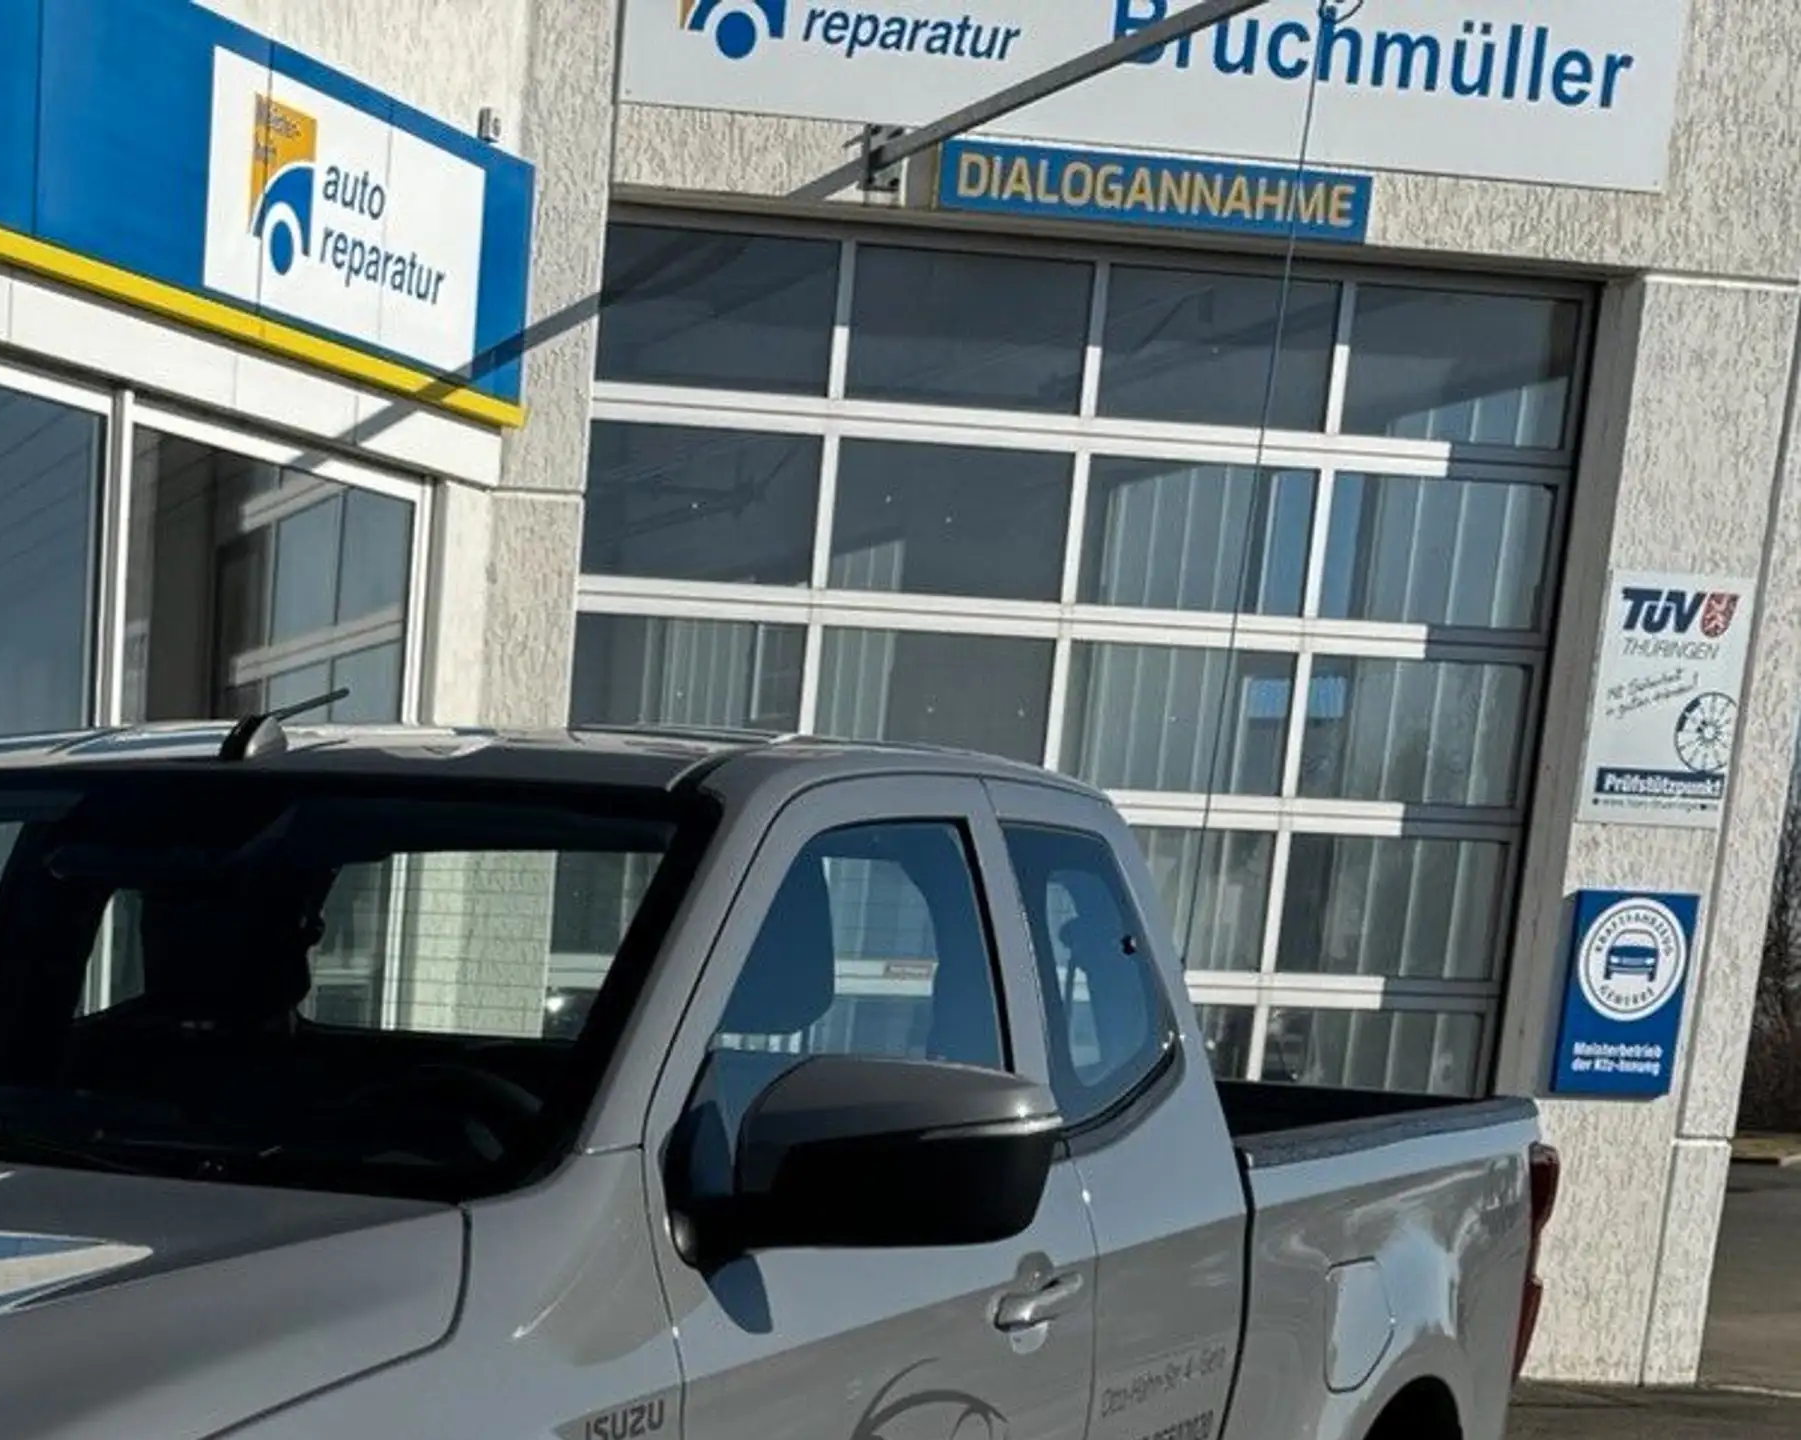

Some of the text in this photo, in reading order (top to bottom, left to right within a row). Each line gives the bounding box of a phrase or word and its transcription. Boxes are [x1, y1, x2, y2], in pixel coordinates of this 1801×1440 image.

[802, 8, 1021, 61] reparatur
[322, 165, 386, 221] auto
[956, 151, 1357, 228] DIALOGANNAHME
[319, 226, 446, 305] reparatur
